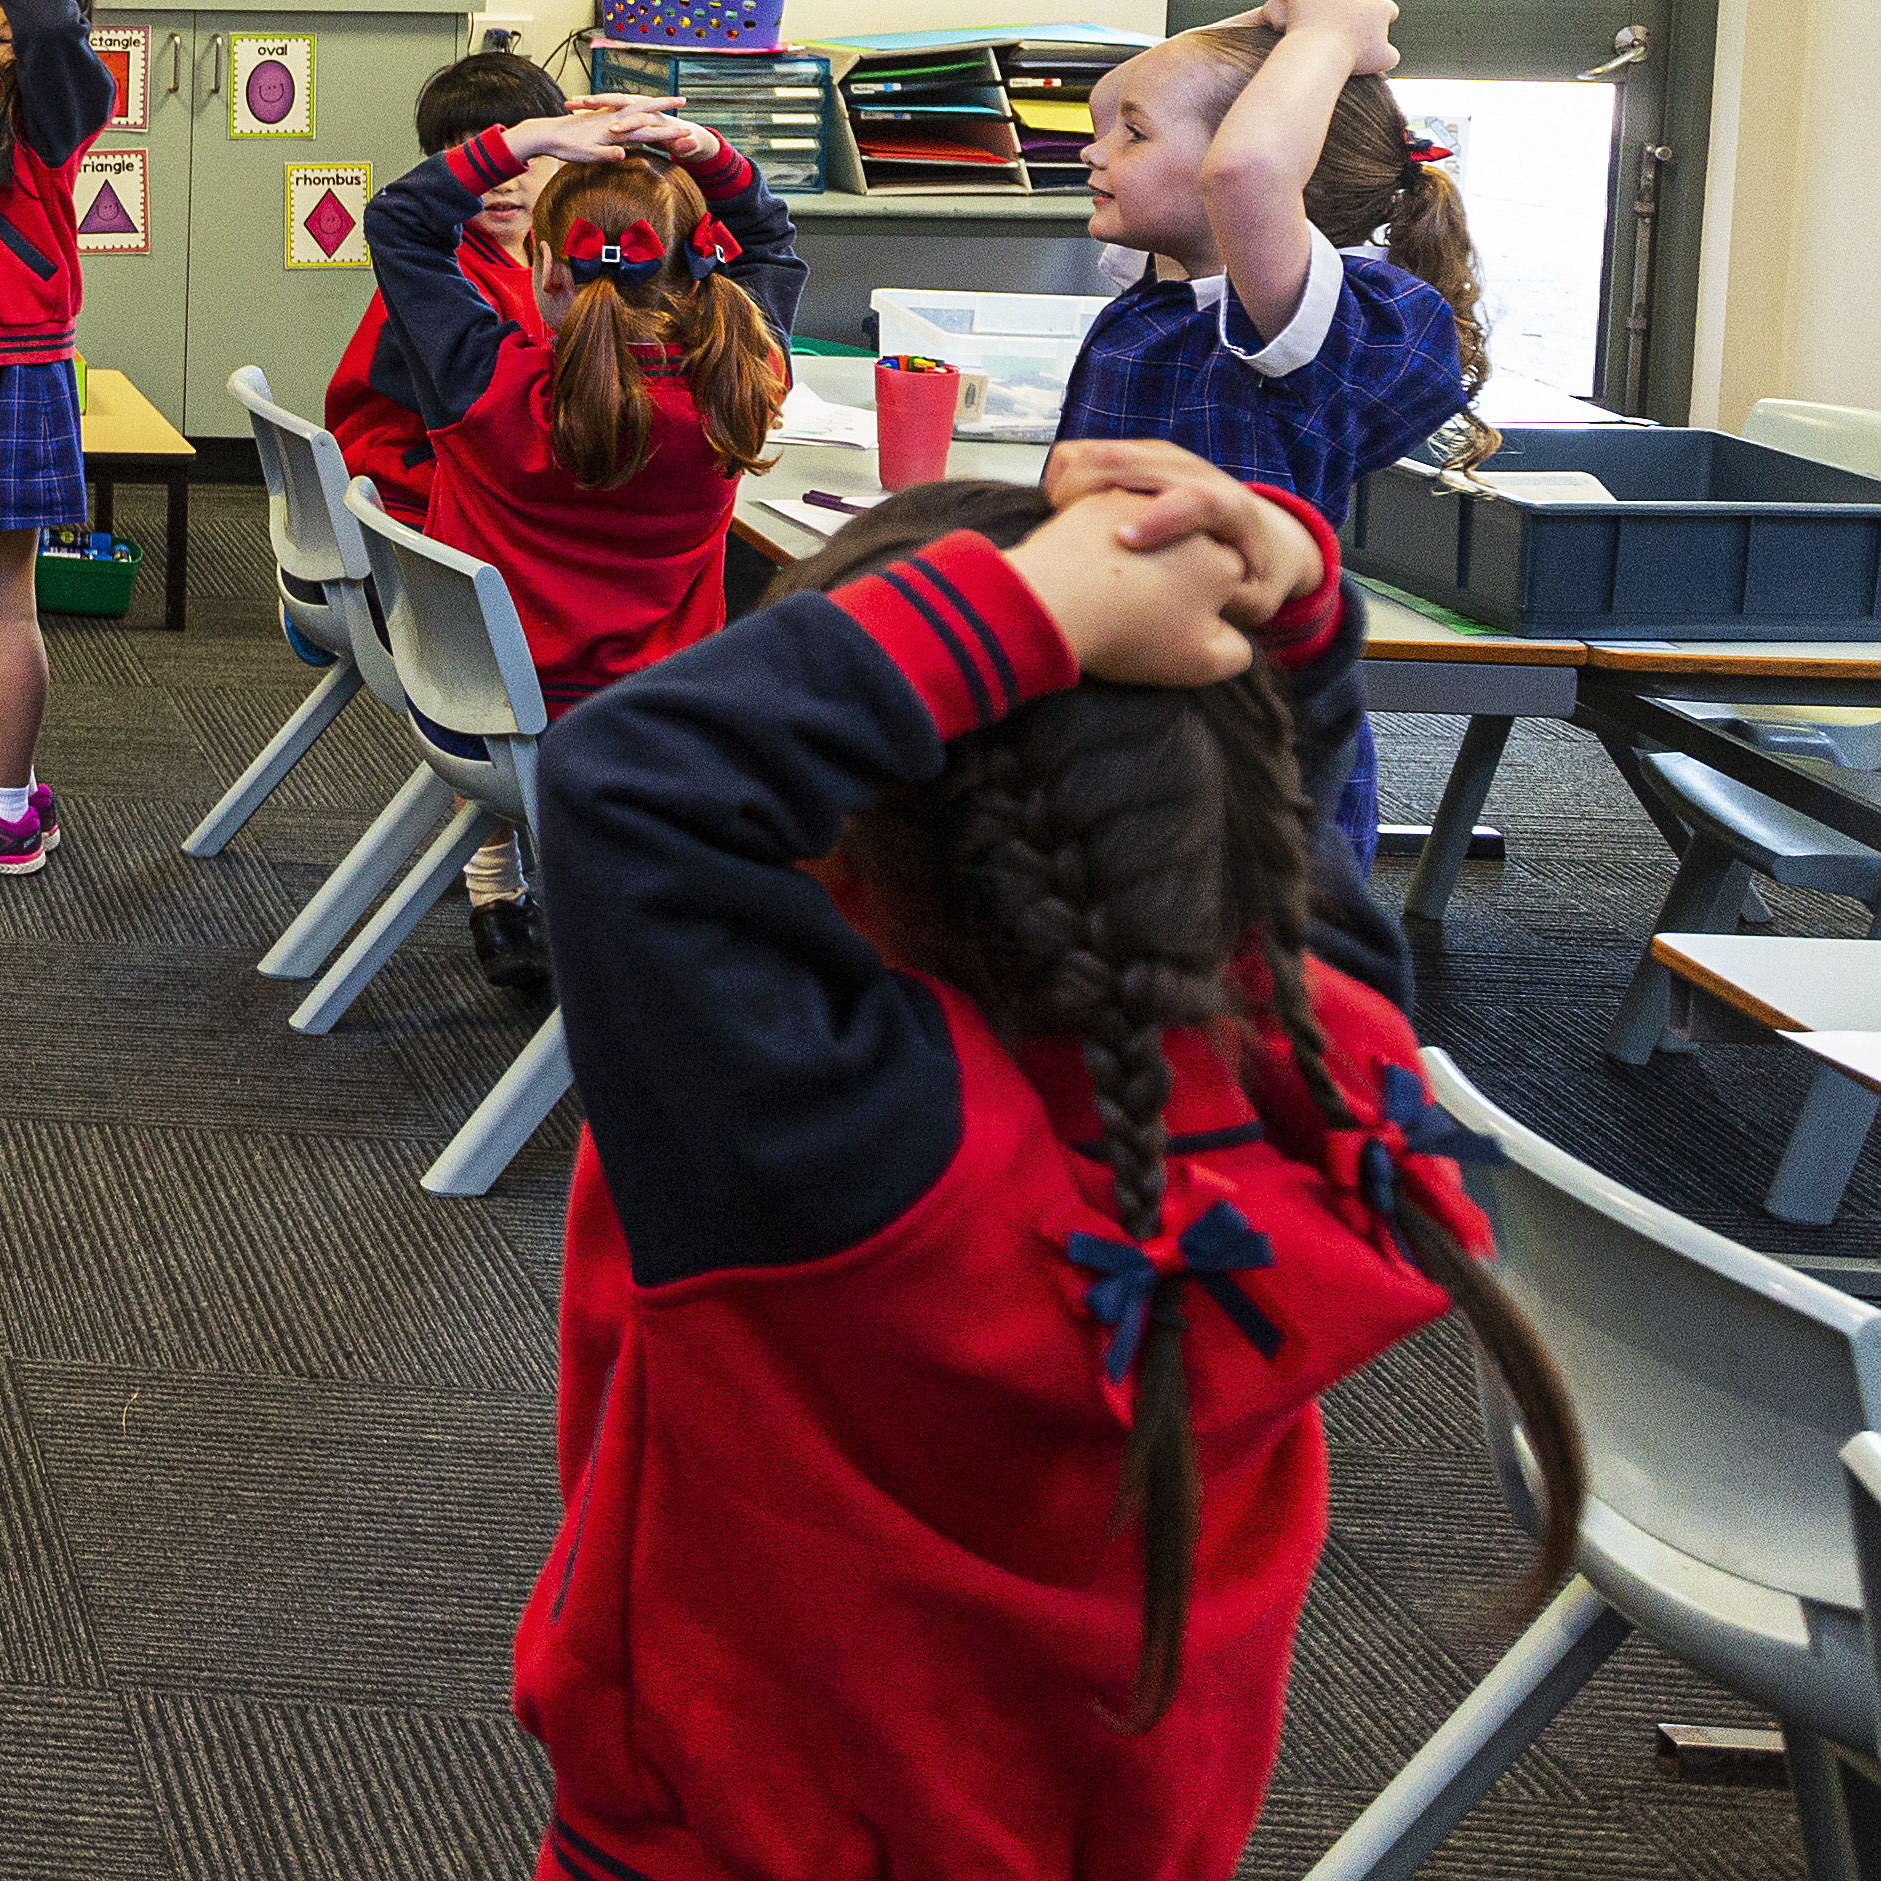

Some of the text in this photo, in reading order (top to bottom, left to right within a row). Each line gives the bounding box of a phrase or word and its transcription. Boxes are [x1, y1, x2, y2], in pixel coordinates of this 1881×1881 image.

[257, 44, 288, 56] oval
[83, 161, 134, 175] riangle
[295, 174, 361, 186] rhombus
